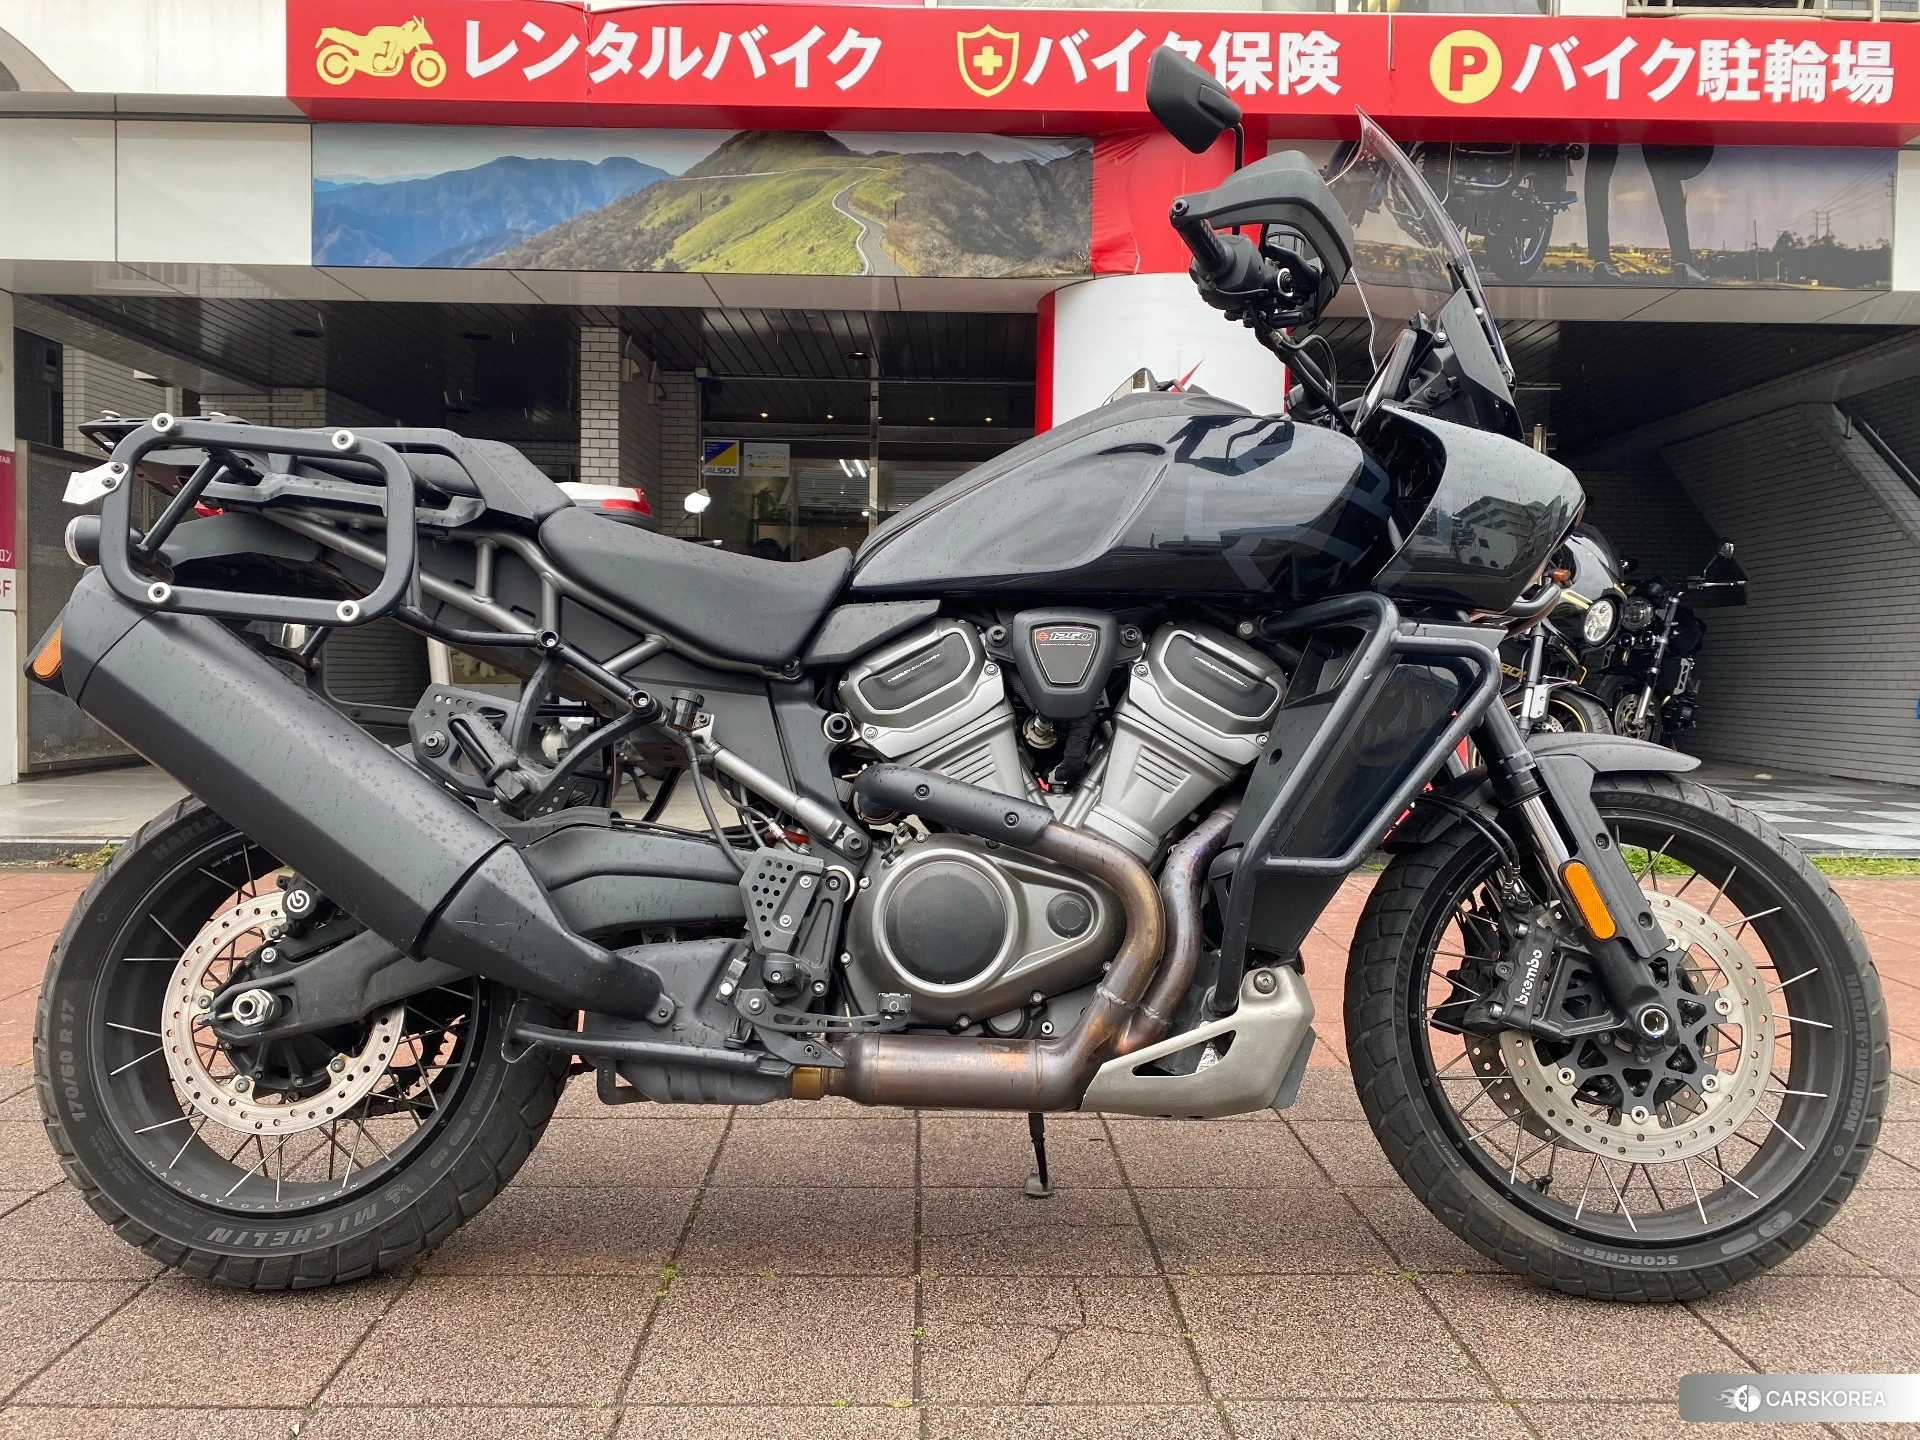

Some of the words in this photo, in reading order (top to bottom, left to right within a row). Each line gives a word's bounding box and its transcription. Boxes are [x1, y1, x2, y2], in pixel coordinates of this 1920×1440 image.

[465, 20, 882, 91] レンタルバイク
[1449, 46, 1488, 91] P
[1511, 35, 1896, 104] バイク駐輪場
[705, 467, 737, 475] ALSOK
[0, 580, 12, 598] F
[1049, 631, 1093, 641] 1250
[1663, 802, 1679, 812] R
[1394, 902, 1426, 1027] MICHELIN
[1514, 949, 1543, 1006] brembo
[61, 999, 75, 1023] 17
[59, 1028, 73, 1044] R
[1844, 974, 1869, 1133] HARLEY-DAVIDSON
[60, 1050, 87, 1122] 170/60
[1440, 1144, 1460, 1167] FRONT
[147, 1160, 358, 1210] HARLEY-DAVIDSON
[1482, 1193, 1506, 1211] 2CT
[207, 1203, 378, 1247] MICHELIN
[1583, 1246, 1679, 1266] SCORCHER
